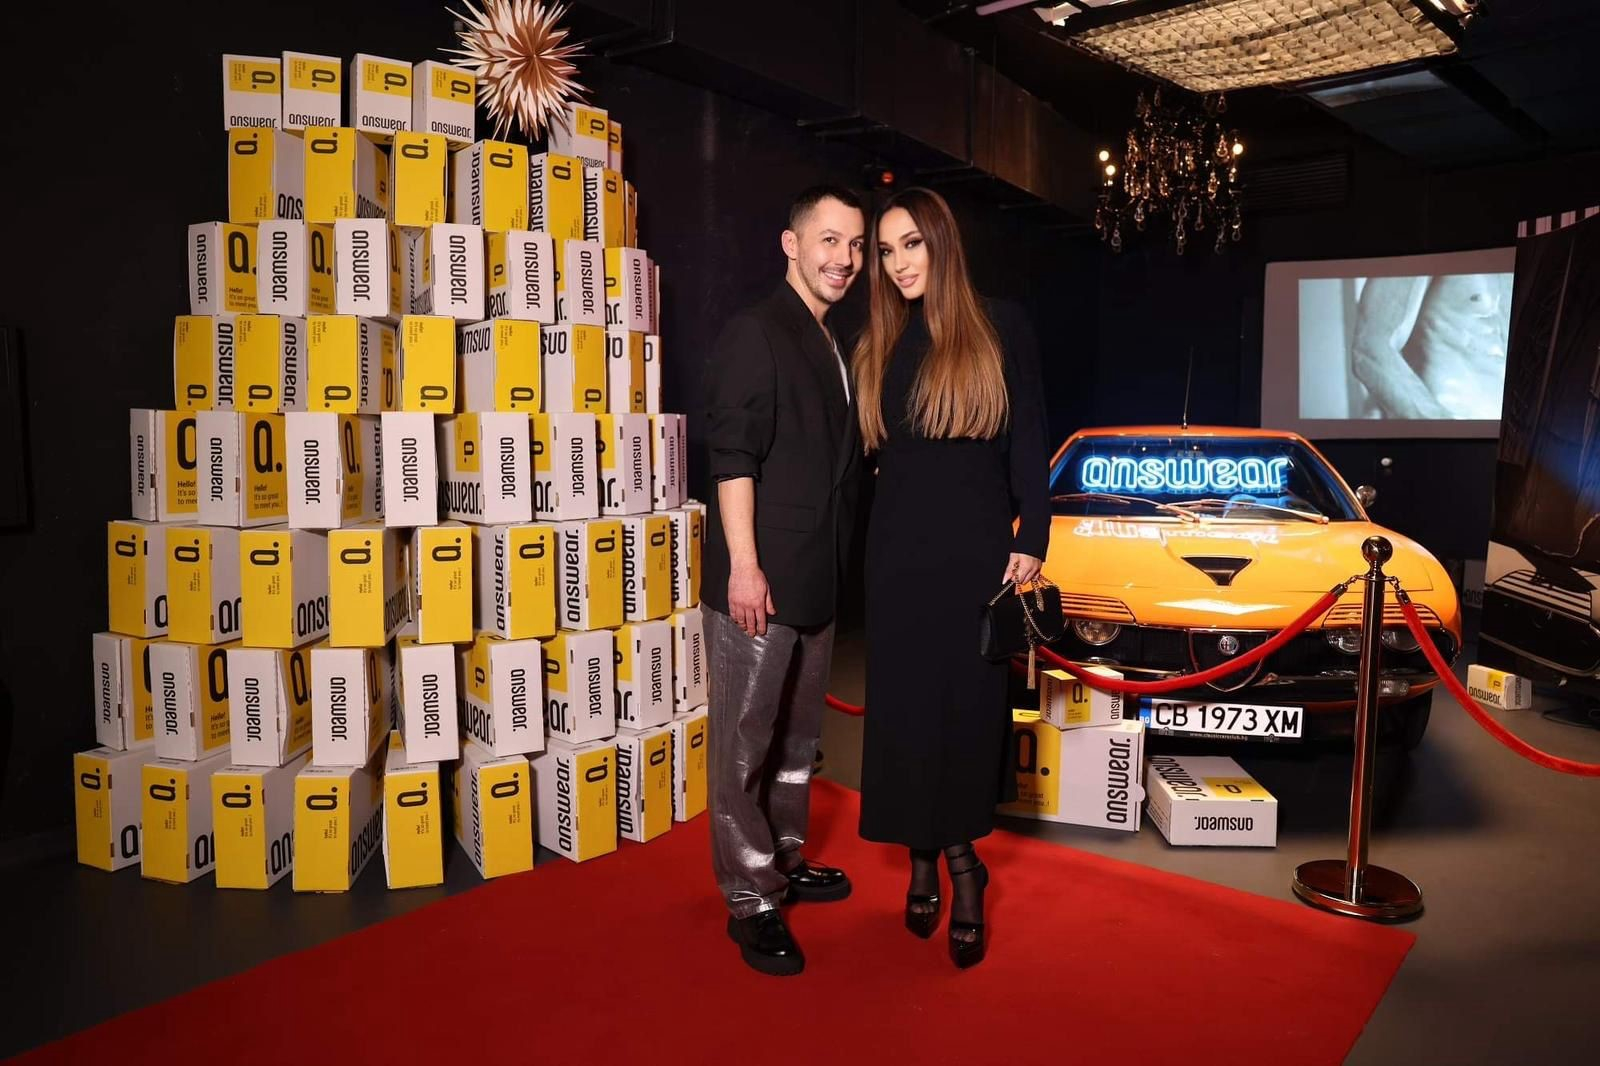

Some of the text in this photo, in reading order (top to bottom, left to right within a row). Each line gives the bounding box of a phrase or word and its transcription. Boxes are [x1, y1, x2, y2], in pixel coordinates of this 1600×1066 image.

[251, 70, 276, 89] a.
[311, 69, 336, 88] a.
[384, 72, 407, 91] a.
[451, 79, 471, 98] a.
[362, 115, 408, 132] answear.
[431, 120, 472, 139] answear.
[590, 119, 605, 134] a.
[234, 132, 258, 155] a.
[311, 132, 338, 154] a.
[401, 138, 429, 160] a.
[489, 148, 513, 169] a.
[552, 160, 571, 181] a.
[272, 231, 288, 303] answear.
[311, 230, 332, 276] a.
[351, 229, 370, 302] answear.
[196, 233, 208, 304] answear.
[449, 235, 467, 305] answear.
[523, 242, 540, 309] answear.
[580, 250, 595, 315] answear.
[633, 258, 643, 320] answear.
[217, 322, 234, 406] answear.
[283, 322, 297, 407] answear.
[360, 323, 369, 406] answear.
[187, 384, 207, 406] a.
[248, 384, 273, 407] a.
[324, 385, 351, 408] a.
[420, 385, 448, 408] a.
[510, 386, 534, 408] a.
[584, 389, 602, 409] a.
[253, 420, 283, 474] a.
[463, 440, 474, 464] a.
[137, 435, 145, 497] answear.
[210, 437, 223, 502] answear.
[304, 440, 321, 504] answear.
[401, 438, 419, 502] answear.
[500, 437, 516, 500] answear.
[570, 437, 585, 498] answear.
[632, 436, 643, 493] answear.
[1081, 456, 1289, 490] answear
[115, 534, 136, 557] a.
[174, 538, 200, 563] a.
[250, 541, 280, 566] a.
[340, 540, 371, 565] a.
[431, 537, 462, 562] a.
[519, 534, 545, 560] a.
[595, 529, 615, 552] a.
[494, 534, 506, 631] answear.
[565, 529, 580, 623] answear.
[693, 633, 701, 688] answear.
[475, 667, 485, 688] a.
[588, 657, 602, 719] answear.
[651, 647, 663, 706] answear.
[101, 662, 111, 725] answear.
[163, 672, 178, 736] answear.
[422, 674, 441, 739] answear.
[511, 668, 528, 732] answear.
[1072, 682, 1088, 704] a.
[244, 678, 261, 742] answear.
[330, 676, 347, 742] answear.
[1155, 703, 1299, 734] CB 1973 XM
[81, 767, 101, 790] a.
[585, 756, 608, 783] a.
[1106, 738, 1131, 824] answear.
[1149, 757, 1208, 798] answear.
[150, 778, 176, 801] a.
[221, 784, 251, 809] a.
[305, 786, 338, 811] a.
[397, 782, 428, 808] a.
[491, 772, 520, 799] a.
[470, 769, 482, 867] answear.
[557, 757, 572, 852] answear.
[1194, 816, 1254, 832] answear.
